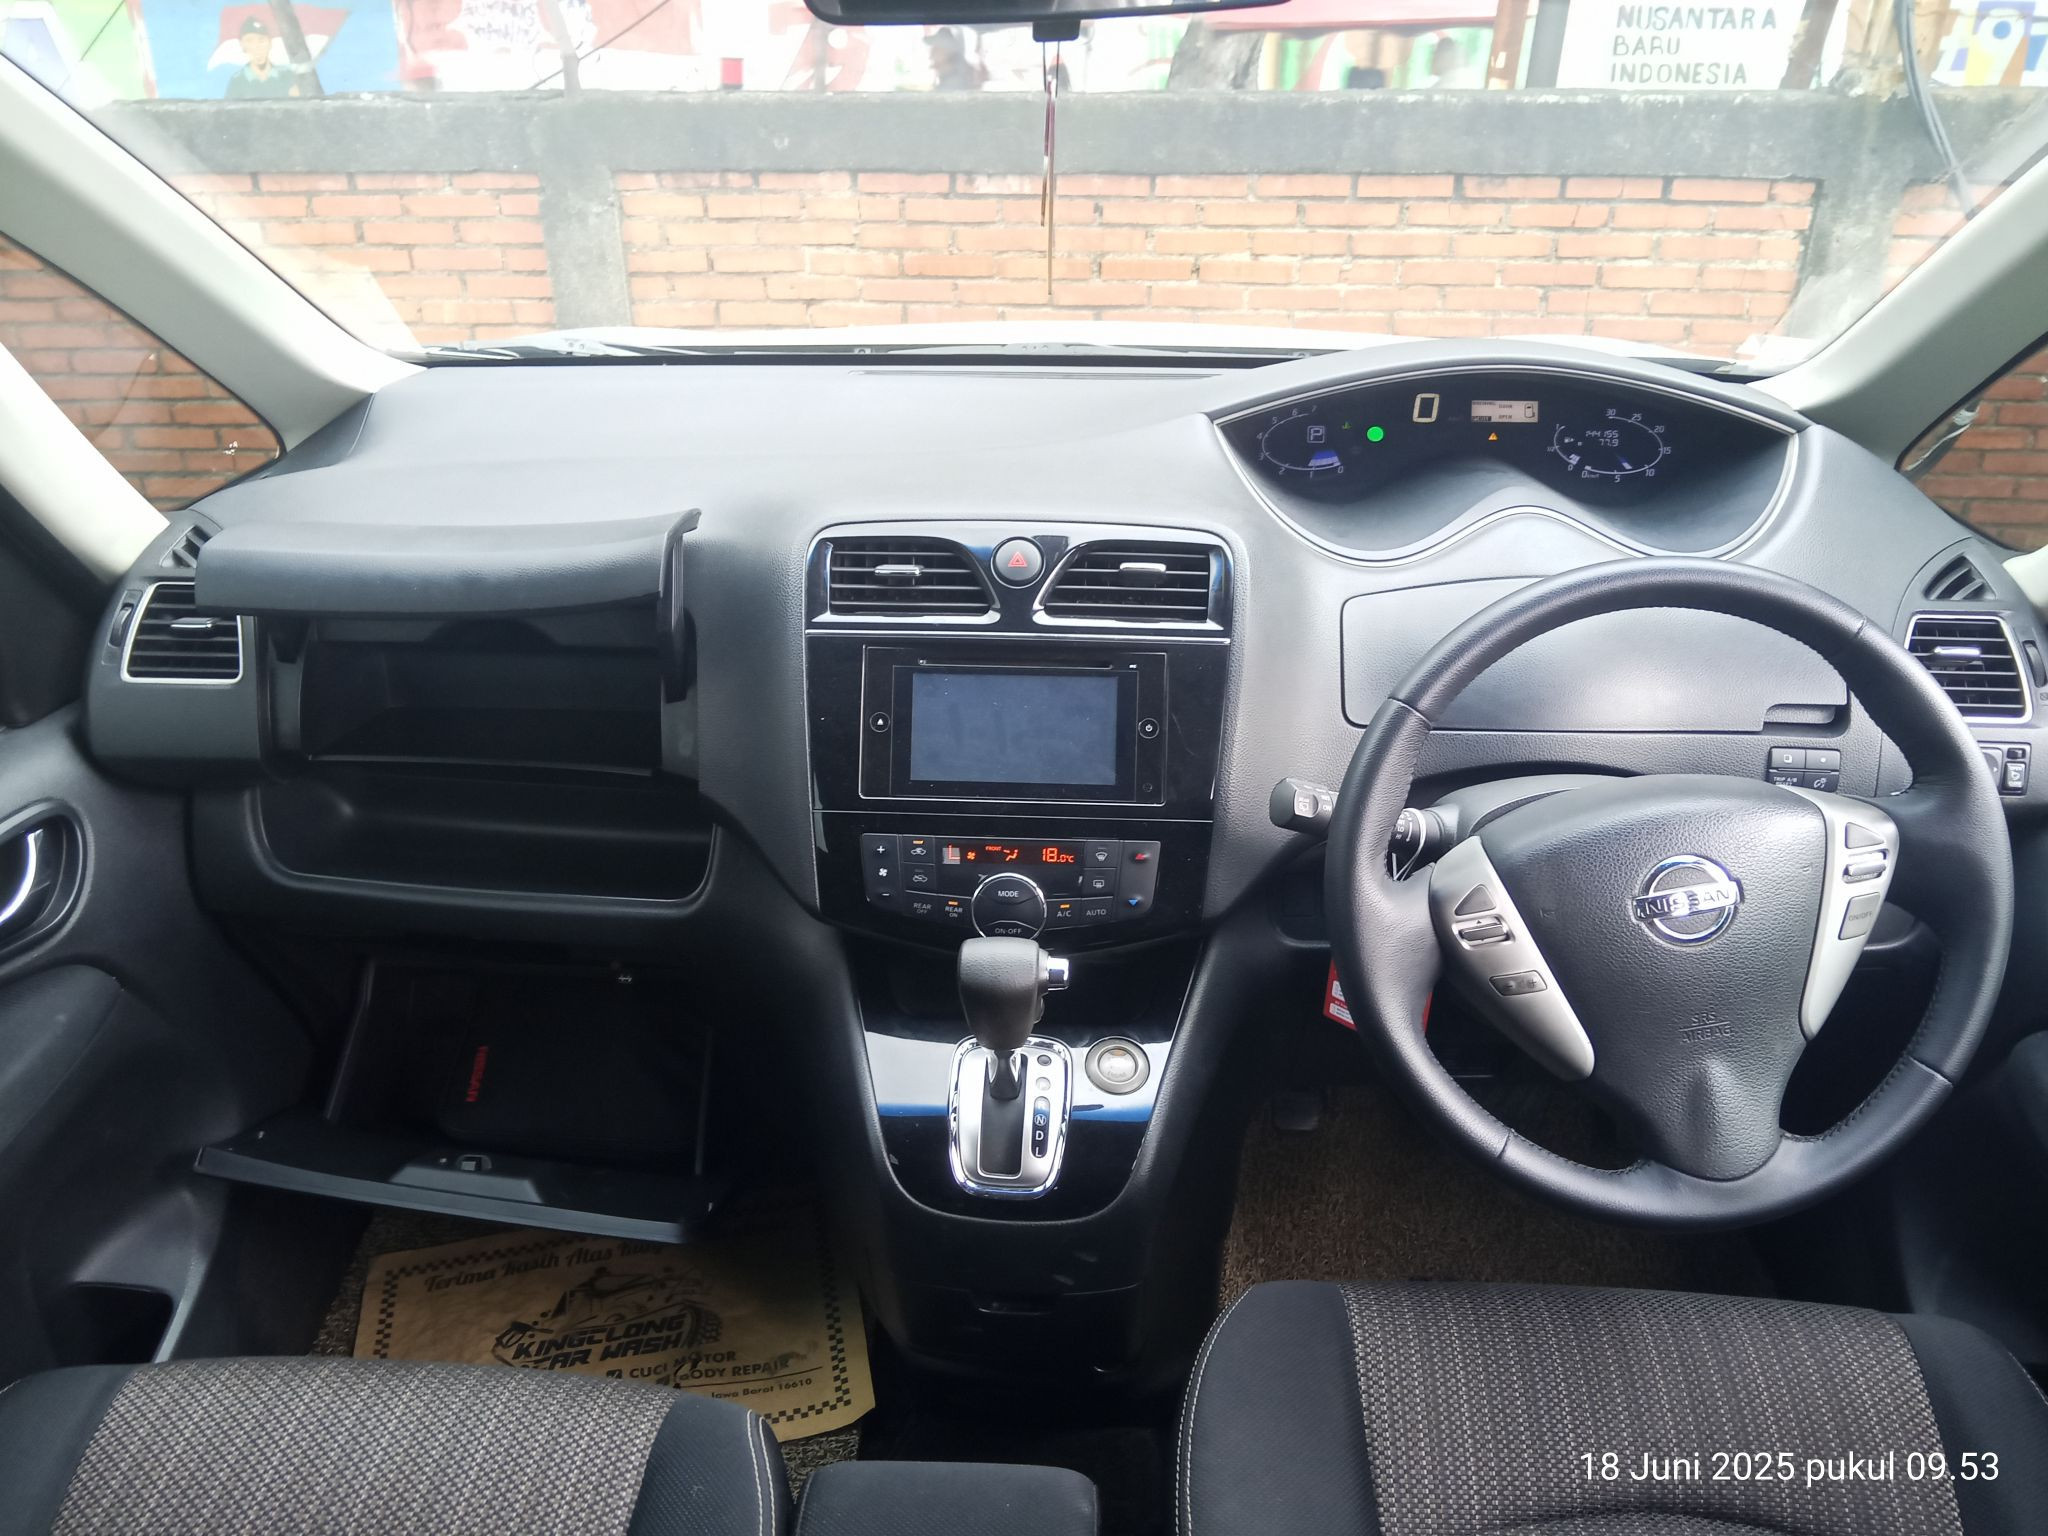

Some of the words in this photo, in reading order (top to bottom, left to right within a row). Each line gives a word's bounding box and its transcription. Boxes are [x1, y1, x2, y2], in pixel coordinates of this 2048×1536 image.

[1616, 5, 1777, 31] NUSANTARA
[1612, 35, 1681, 56] BARU
[1610, 62, 1747, 85] INDONESIA
[1631, 413, 1642, 421] 25
[1654, 425, 1665, 433] 20
[1663, 446, 1672, 455] 15
[1645, 468, 1655, 477] 10
[997, 890, 1019, 898] MODE
[913, 902, 932, 910] REAR
[1056, 910, 1072, 918] A/C
[1086, 909, 1107, 917] AUTO
[1036, 1115, 1045, 1125] N
[1035, 1130, 1044, 1141] D
[1035, 1147, 1043, 1157] L
[424, 1267, 497, 1292] Terima
[600, 1331, 684, 1362] WASH
[629, 1365, 668, 1379] CUCI
